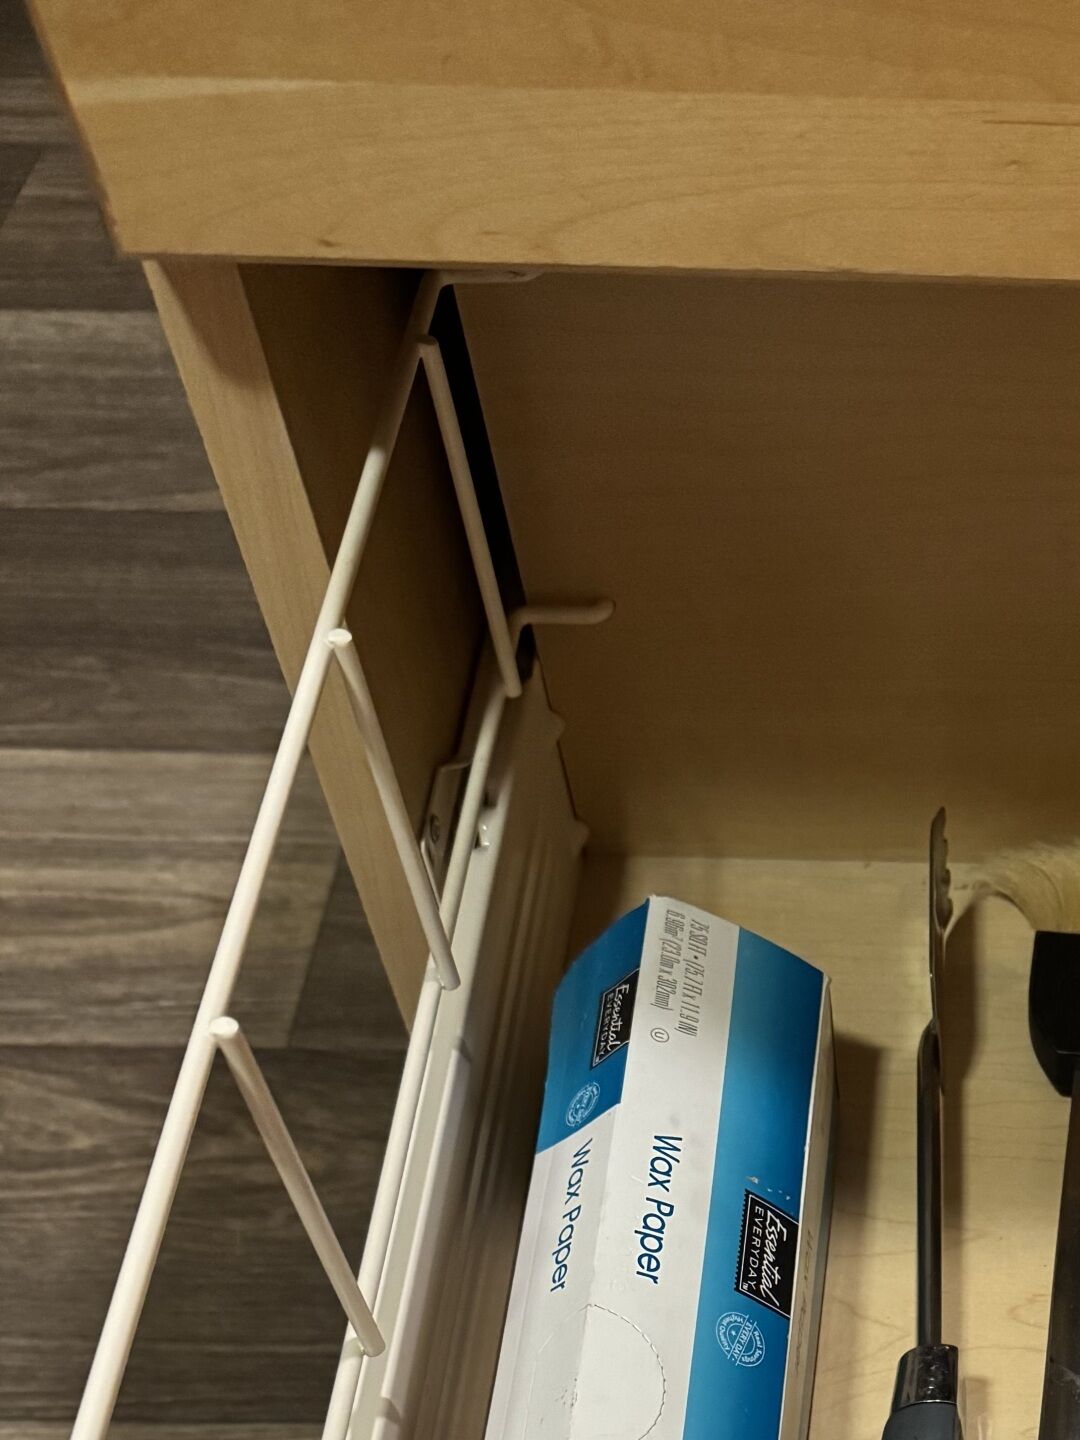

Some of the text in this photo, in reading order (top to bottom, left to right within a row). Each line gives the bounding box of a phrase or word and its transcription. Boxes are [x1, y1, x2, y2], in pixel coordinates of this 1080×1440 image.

[688, 941, 707, 956] FT
[607, 983, 630, 1052] Essential
[683, 982, 703, 997] FT
[598, 992, 614, 1056] EVERYDAY
[565, 1137, 593, 1205] Wax
[634, 1135, 683, 1285] Wax Paper
[550, 1205, 582, 1292] Paper
[747, 1205, 765, 1290] EVERYDAY
[759, 1209, 787, 1306] Essential
[733, 1321, 752, 1360] EVERY DAY
